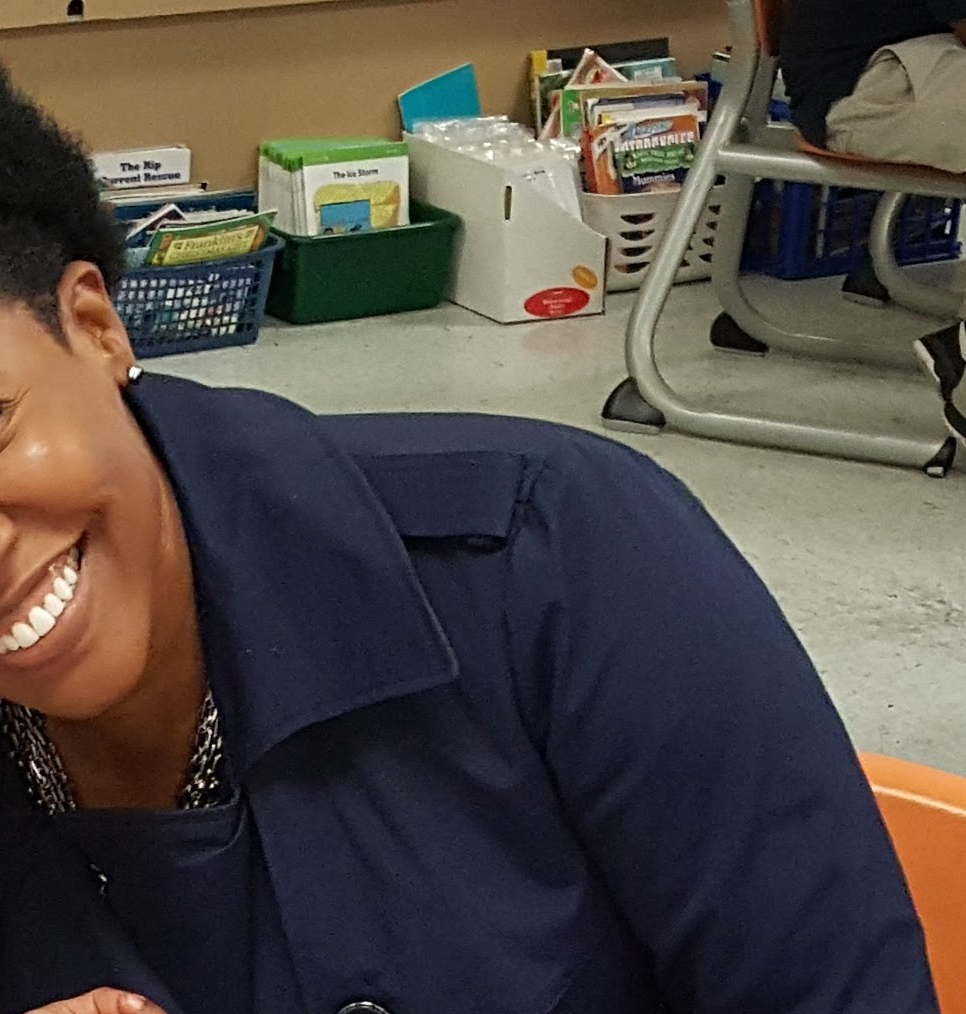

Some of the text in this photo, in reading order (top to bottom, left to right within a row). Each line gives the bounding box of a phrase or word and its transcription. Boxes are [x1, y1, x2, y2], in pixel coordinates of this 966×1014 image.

[120, 160, 161, 172] The Rip
[332, 171, 346, 179] The
[358, 168, 379, 177] Storm
